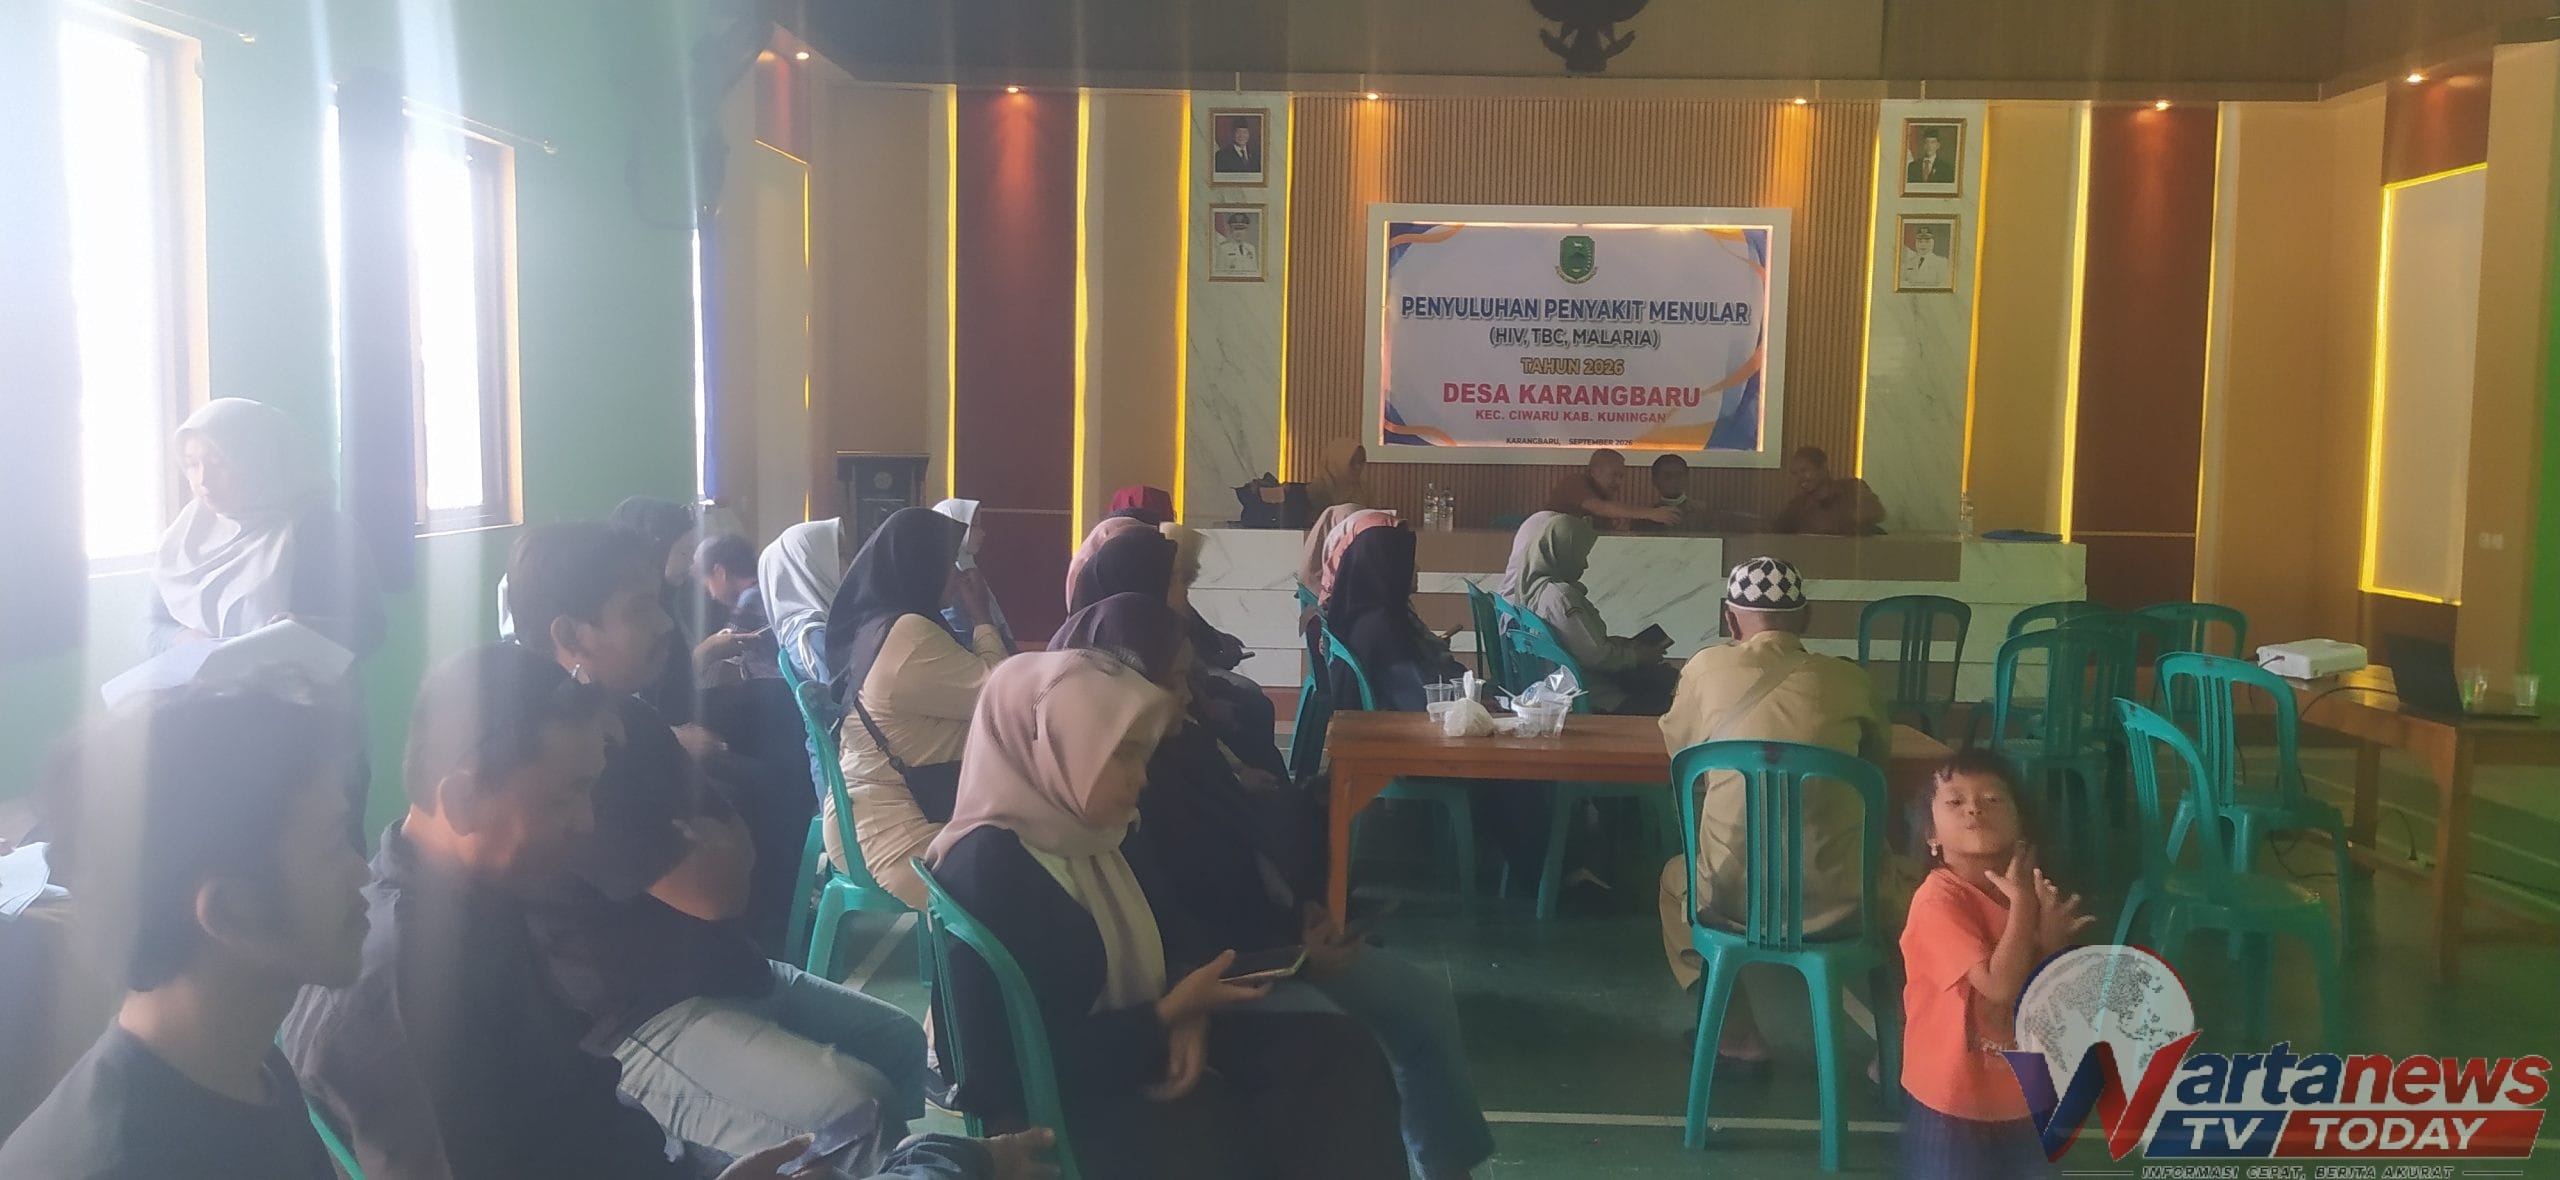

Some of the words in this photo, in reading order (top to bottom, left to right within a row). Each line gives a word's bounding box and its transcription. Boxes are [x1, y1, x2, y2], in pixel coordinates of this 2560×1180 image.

[1402, 296, 1539, 321] PENYULUHAN
[1544, 299, 1645, 321] PENYAKIT
[1649, 301, 1750, 323] MENULAR
[1489, 328, 1530, 347] (HIV,
[1532, 329, 1569, 347] TBC,
[1573, 329, 1660, 348] MALARIA)
[1520, 357, 1581, 375] TAHUN
[1584, 358, 1625, 375] 2026
[1443, 383, 1510, 403] DESA
[1519, 384, 1701, 406] KARANGBARU
[1475, 410, 1505, 420] KEC.
[1509, 410, 1559, 421] CIWARU
[1563, 411, 1594, 421] KAB.
[1598, 412, 1666, 422] KUNINGAN
[1506, 437, 1561, 446] KARANGBARU,
[1568, 438, 1614, 446] SEPTEMBER
